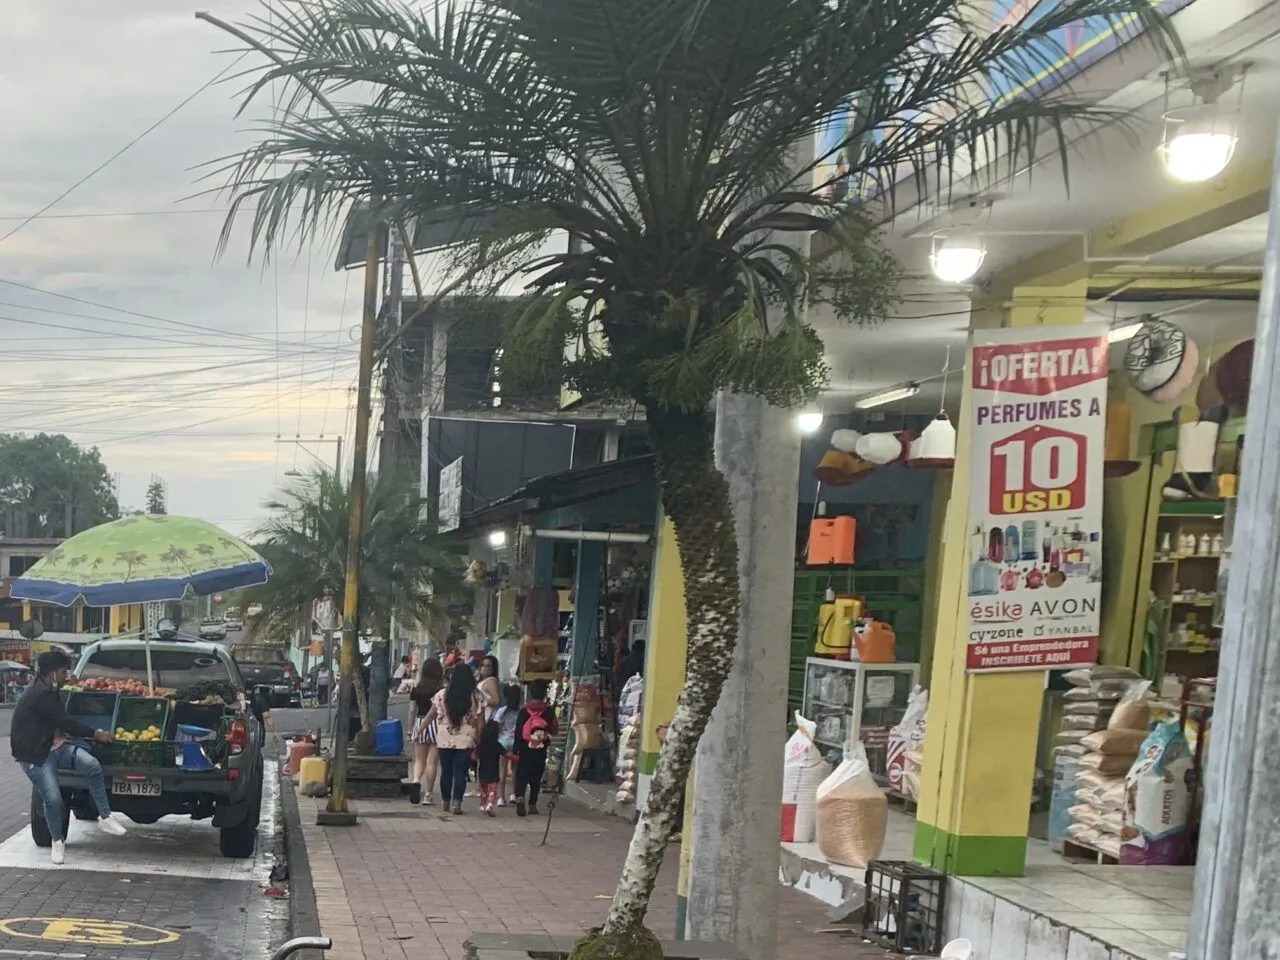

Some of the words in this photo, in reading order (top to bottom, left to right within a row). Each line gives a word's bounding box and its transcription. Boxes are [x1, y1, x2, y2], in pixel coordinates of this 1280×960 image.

[980, 346, 1101, 386] ¡OFERTA!
[977, 398, 1082, 425] PERFUMES
[1088, 397, 1100, 416] A
[993, 436, 1079, 491] 10
[1002, 489, 1071, 513] USD
[971, 601, 1023, 620] ésika
[1030, 598, 1096, 616] AVON
[1048, 625, 1093, 635] YANBAL
[975, 646, 988, 655] Sé
[1013, 640, 1089, 653] Emprendedora
